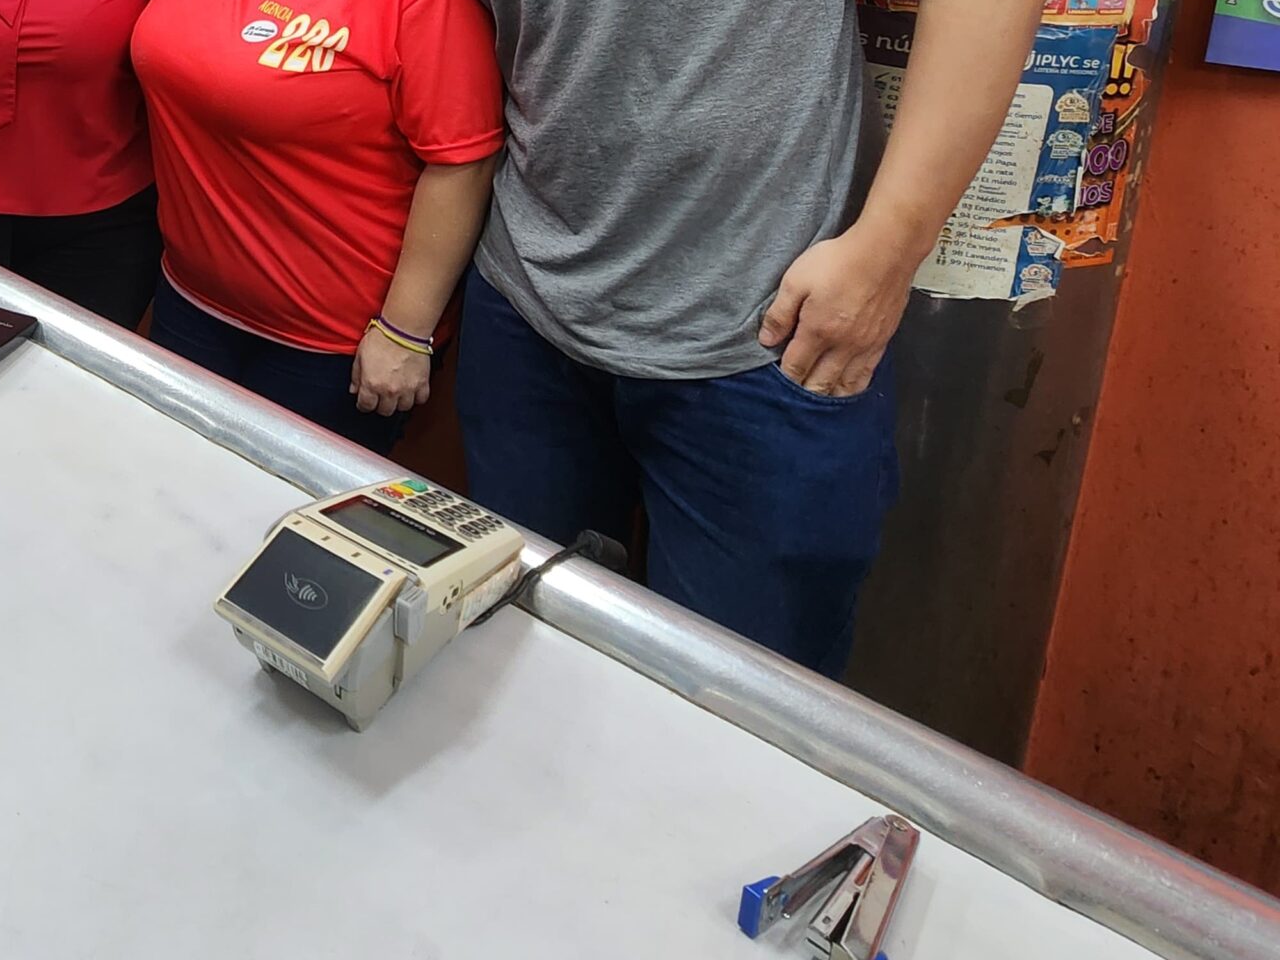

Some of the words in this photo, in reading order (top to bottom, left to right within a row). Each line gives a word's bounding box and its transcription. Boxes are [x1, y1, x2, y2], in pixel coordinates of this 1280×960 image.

[258, 0, 294, 23] AGENCIA
[257, 13, 350, 73] 220
[1036, 54, 1081, 68] IPLYC
[1082, 58, 1101, 69] se
[992, 178, 1018, 187] miedo
[965, 251, 1009, 264] Lavandera
